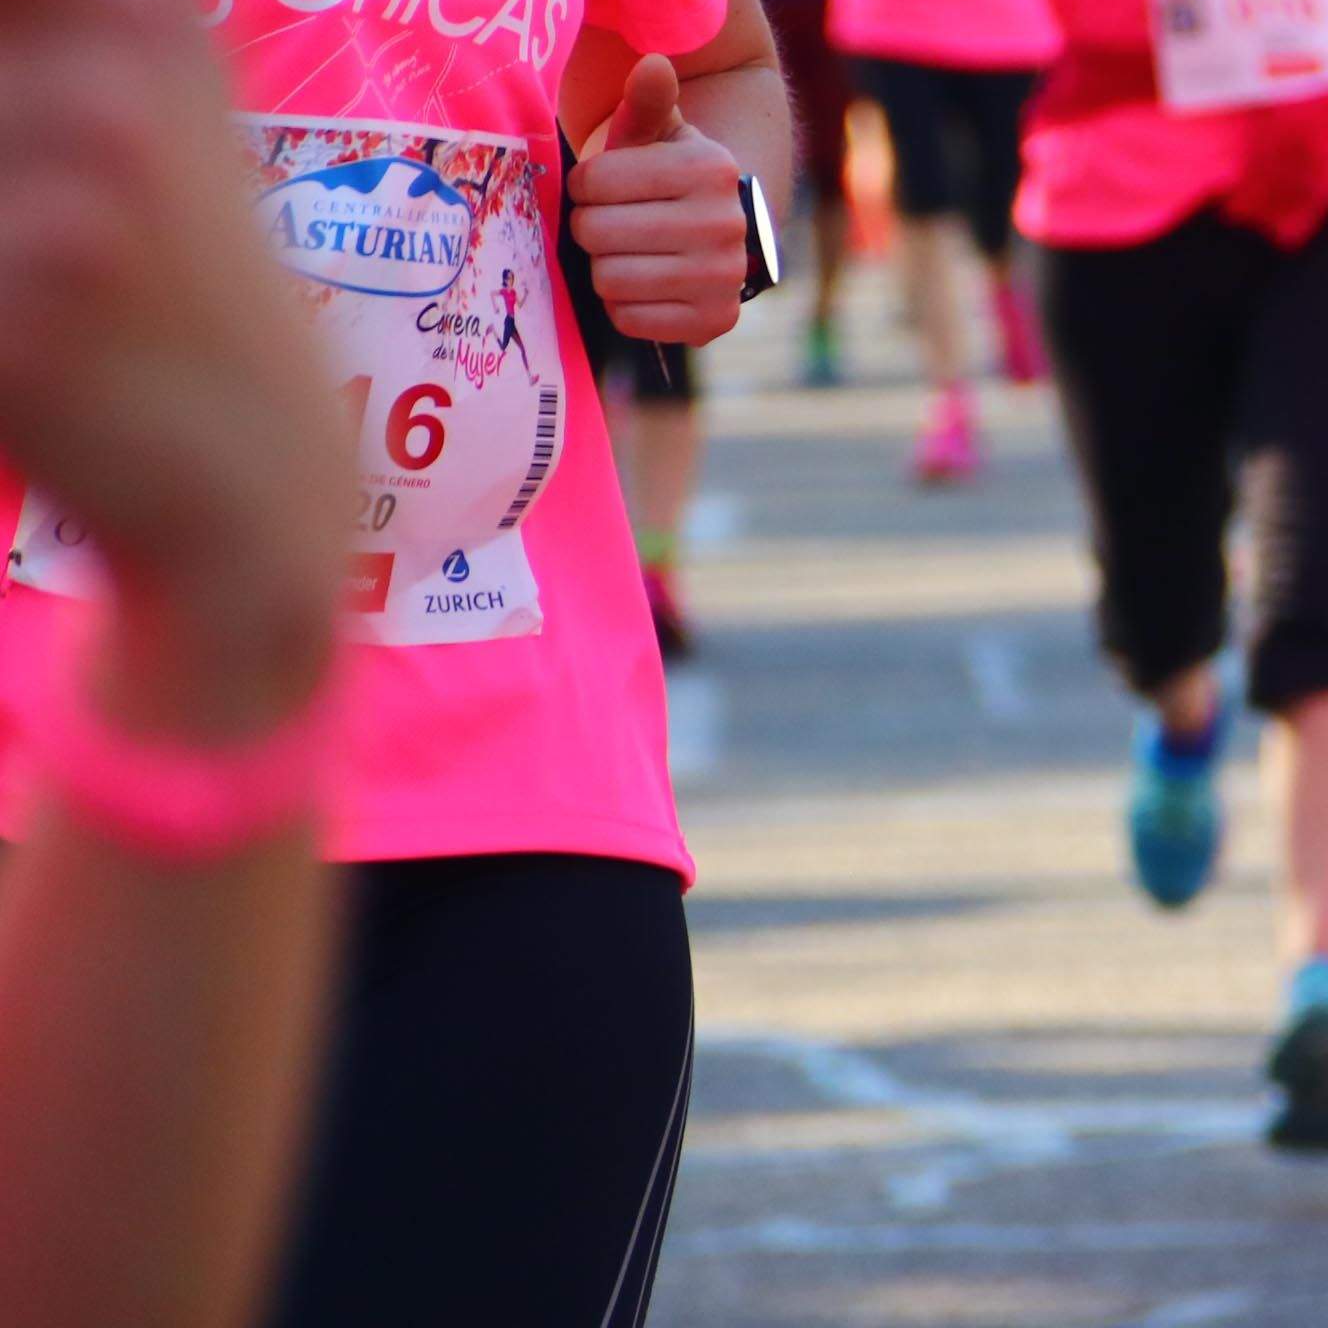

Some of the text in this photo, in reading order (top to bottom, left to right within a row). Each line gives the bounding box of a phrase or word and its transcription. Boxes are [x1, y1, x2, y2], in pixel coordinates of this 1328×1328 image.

[264, 199, 463, 267] ASTURIANA
[454, 337, 507, 390] Mujer
[424, 590, 505, 615] ZURICH
